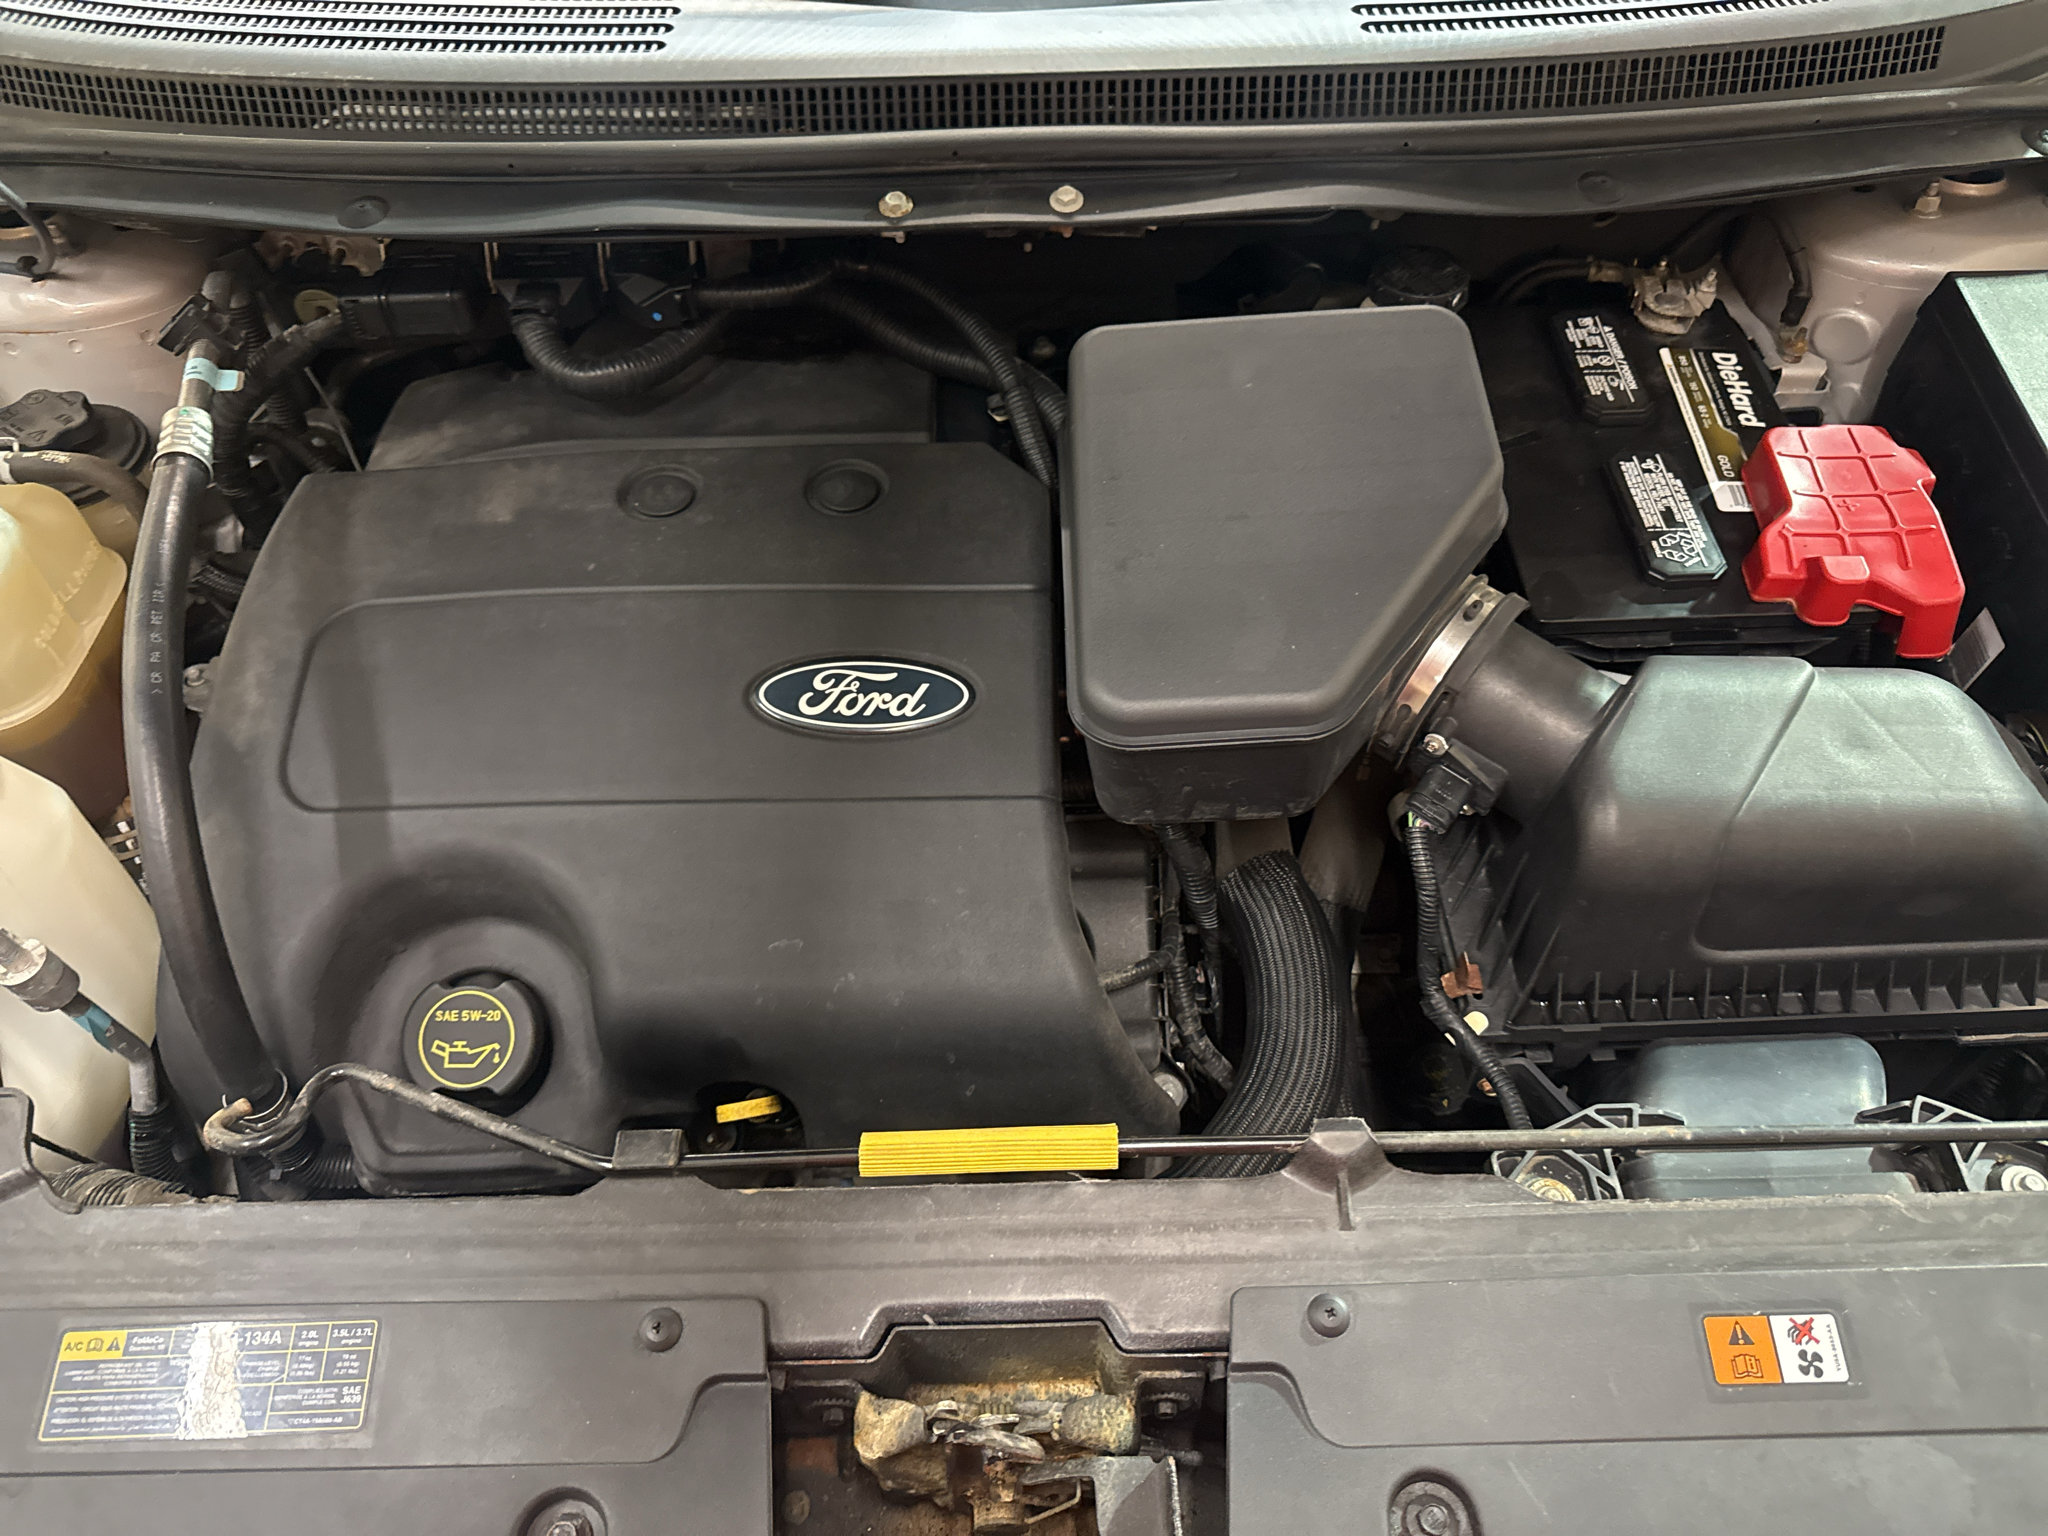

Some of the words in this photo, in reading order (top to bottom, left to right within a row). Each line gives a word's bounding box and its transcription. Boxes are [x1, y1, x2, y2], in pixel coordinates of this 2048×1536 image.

[1606, 332, 1625, 359] DANGER
[1619, 365, 1638, 389] POISON
[1712, 352, 1766, 428] DieHard
[1717, 455, 1735, 478] GOLD
[798, 669, 930, 717] Ford
[435, 1010, 459, 1022] SAE
[461, 1010, 501, 1022] 5W-20
[332, 1329, 349, 1338] 3.5L
[355, 1328, 373, 1336] 3.7L
[64, 1342, 84, 1352] A/C
[342, 1386, 361, 1395] SAE
